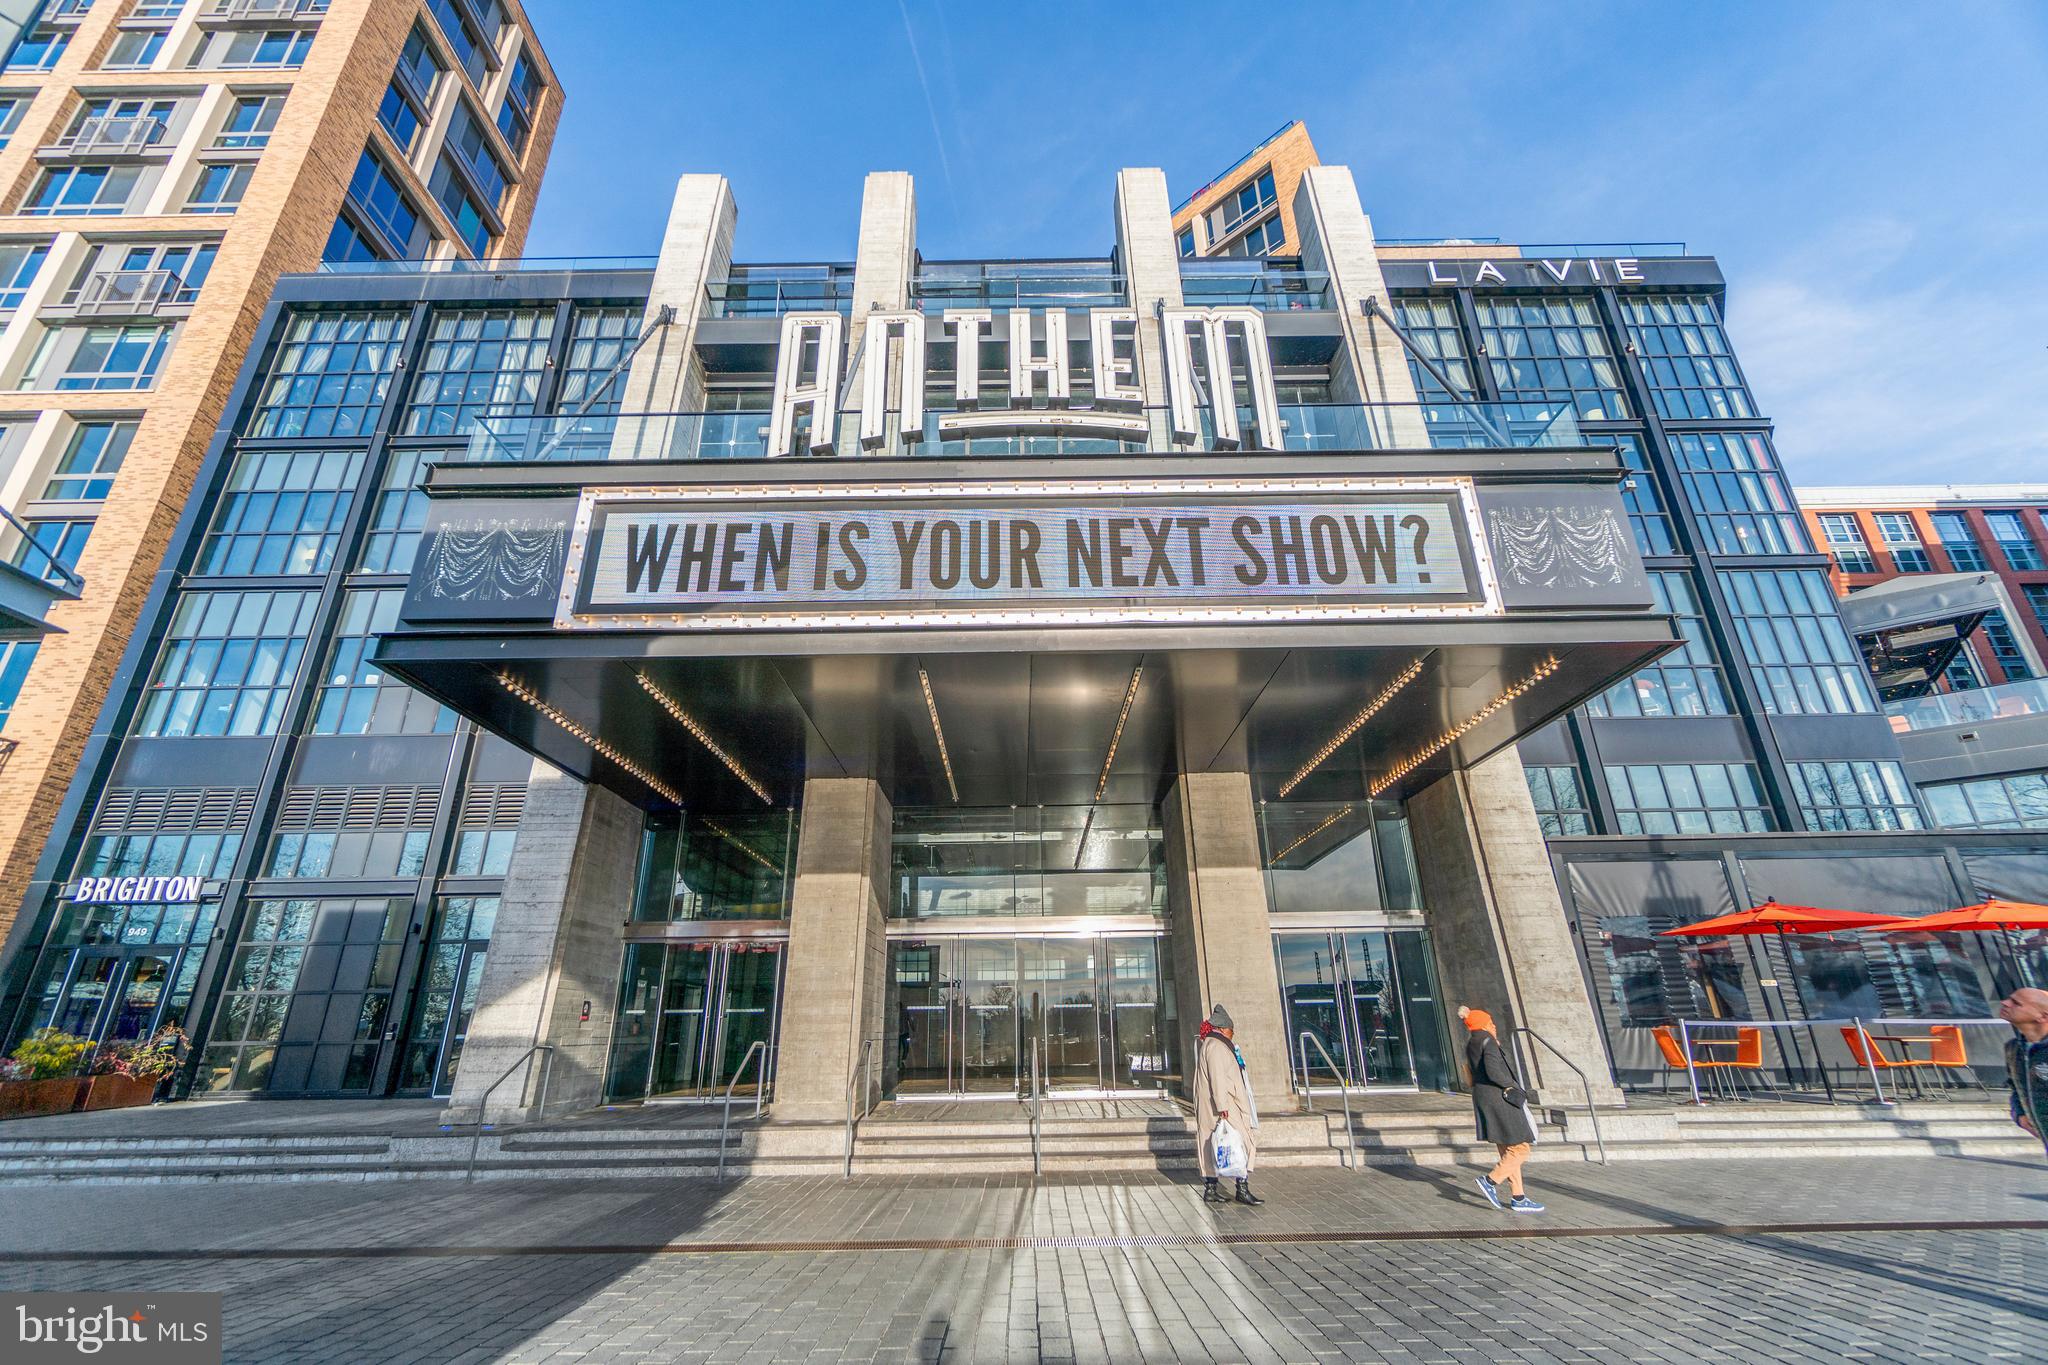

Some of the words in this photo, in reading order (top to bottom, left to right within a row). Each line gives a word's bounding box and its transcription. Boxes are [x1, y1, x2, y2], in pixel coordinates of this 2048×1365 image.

[1427, 261, 1507, 286] LA
[1539, 259, 1645, 285] VIE
[768, 306, 1285, 457] ANTHEM
[626, 522, 795, 594] WHEN
[813, 520, 870, 592] IS
[892, 519, 1044, 590] YOUR
[1066, 517, 1210, 588] NEXT
[1231, 514, 1432, 586] SHOW?
[74, 876, 203, 903] BRIGHTON
[127, 927, 148, 937] 949
